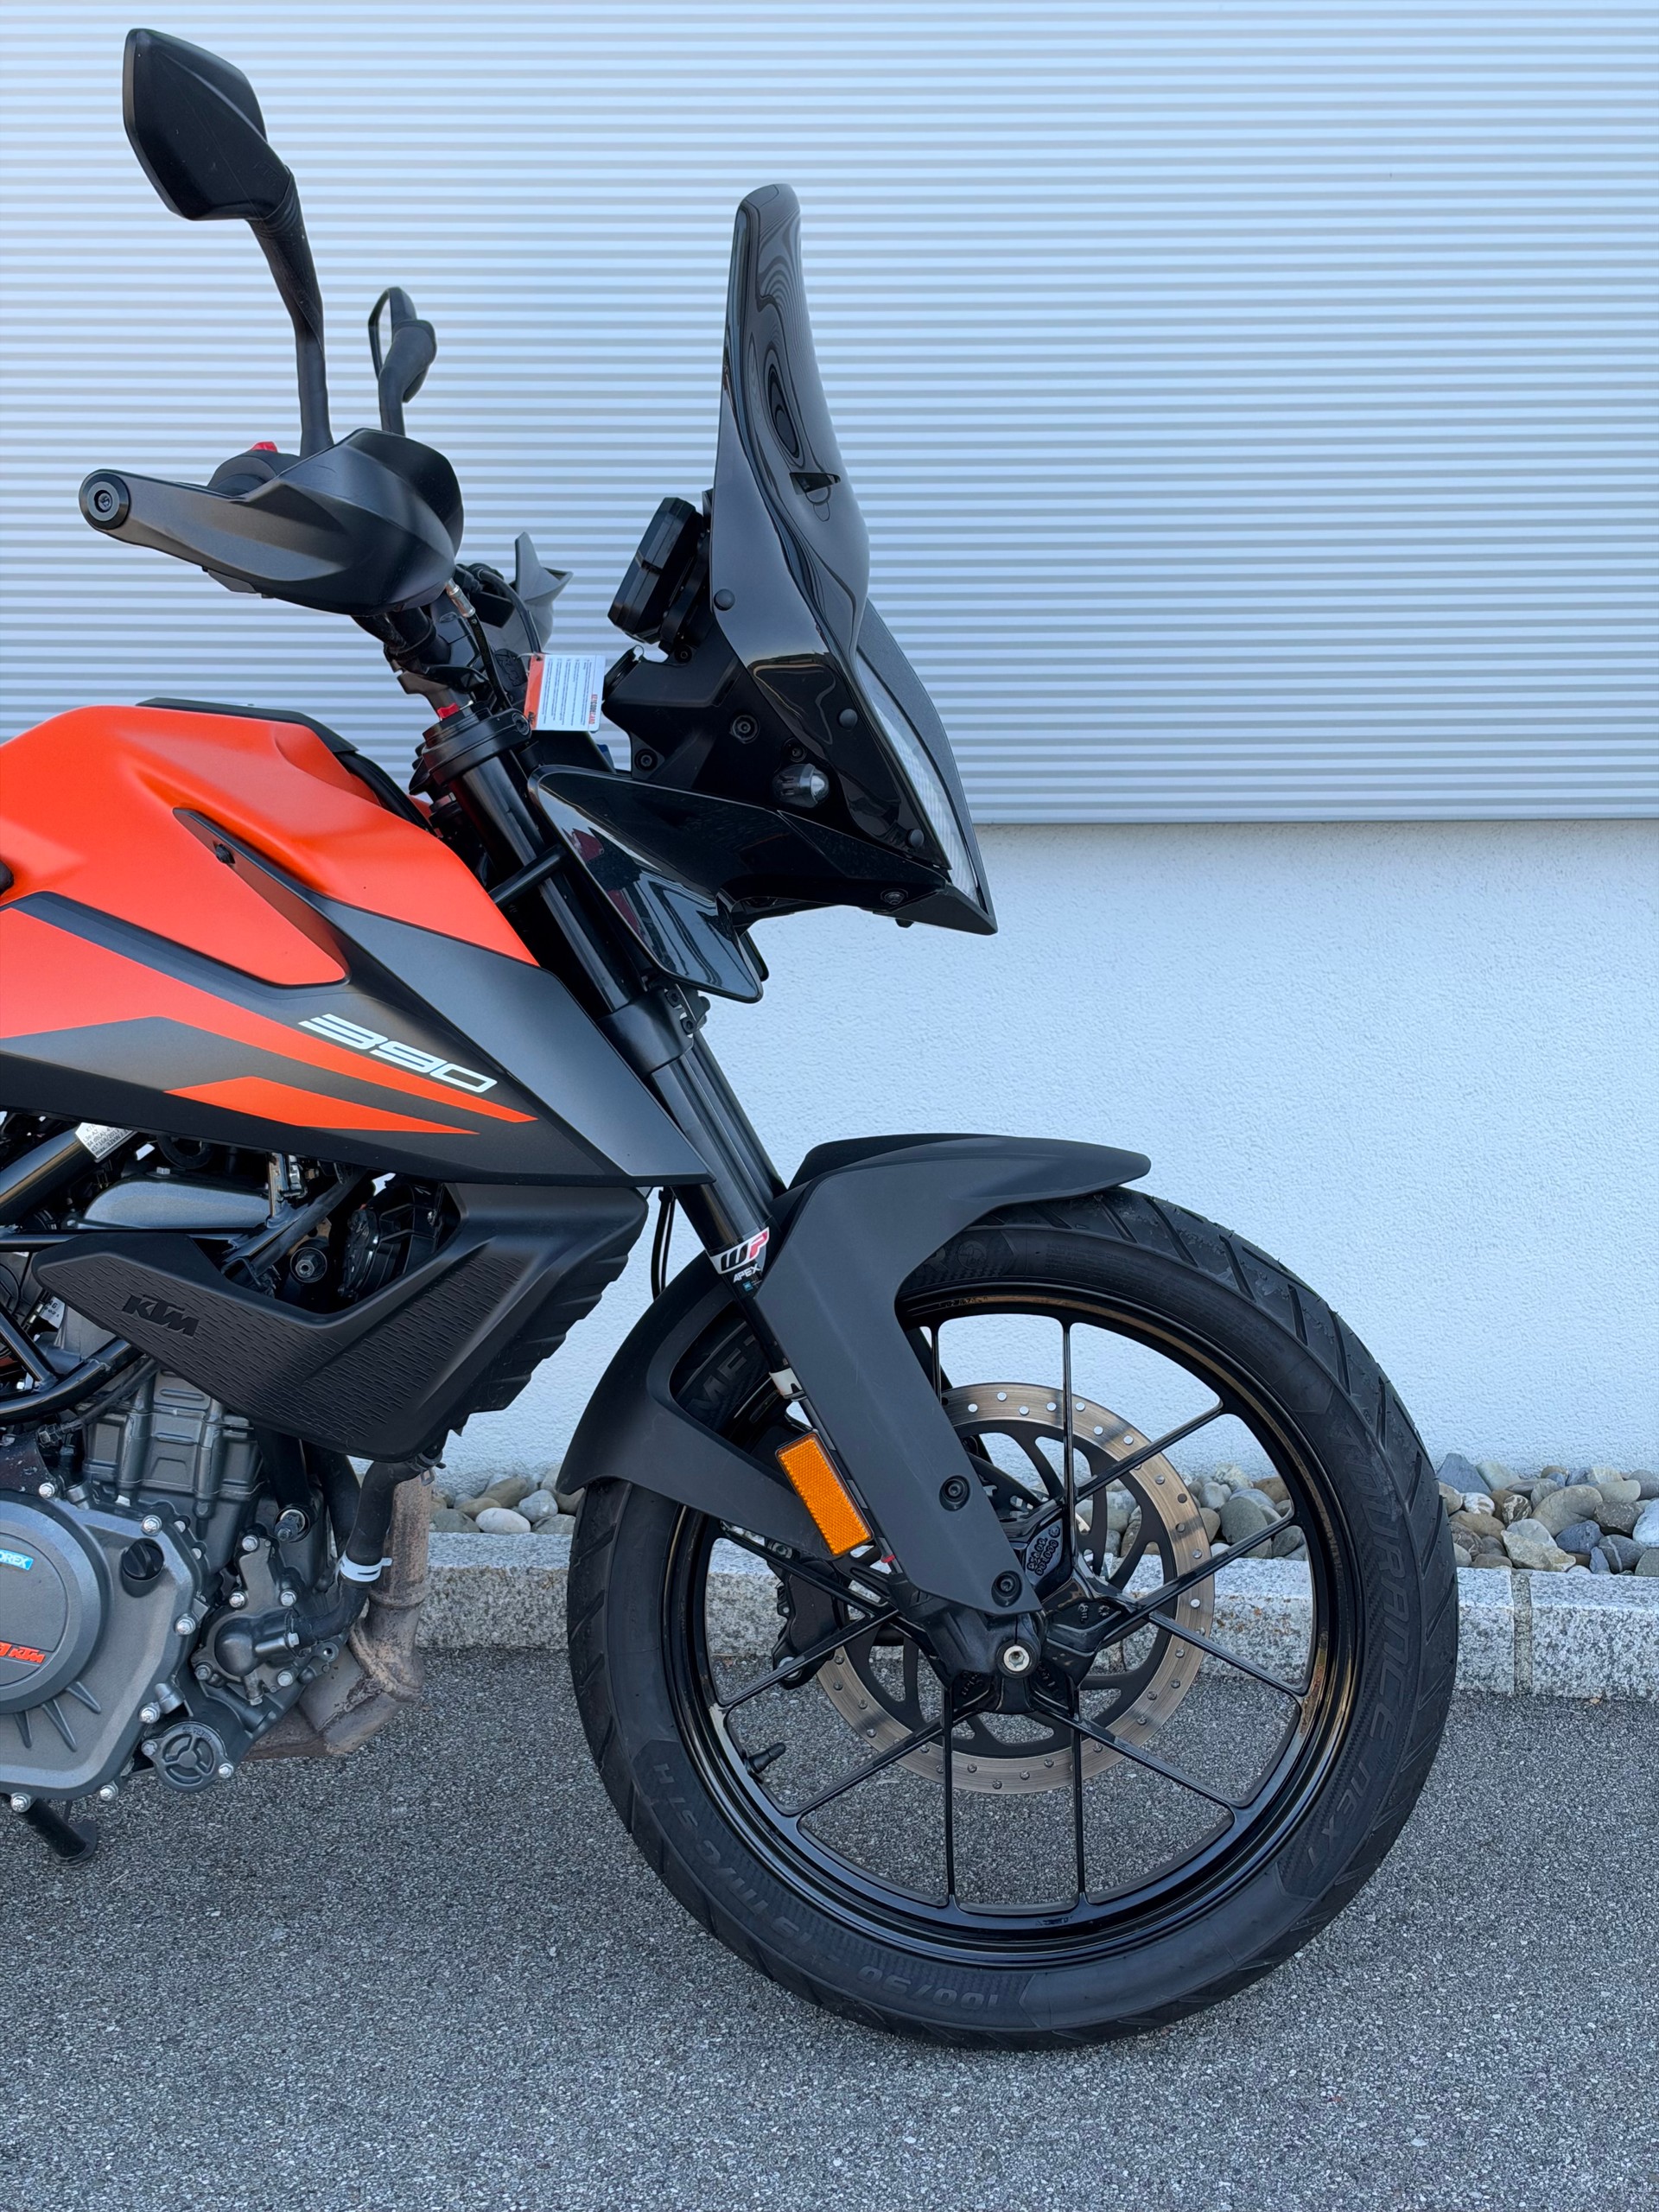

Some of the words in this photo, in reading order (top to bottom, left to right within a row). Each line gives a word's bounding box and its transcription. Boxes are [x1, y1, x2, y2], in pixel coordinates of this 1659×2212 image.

[298, 1014, 498, 1093] 390
[721, 1230, 768, 1272] WP
[733, 1263, 761, 1283] APEX
[122, 1295, 200, 1338] KTM
[1329, 1423, 1410, 1749] TOURANCE
[9, 1645, 45, 1663] KTM
[857, 1964, 999, 2011] 100/90
